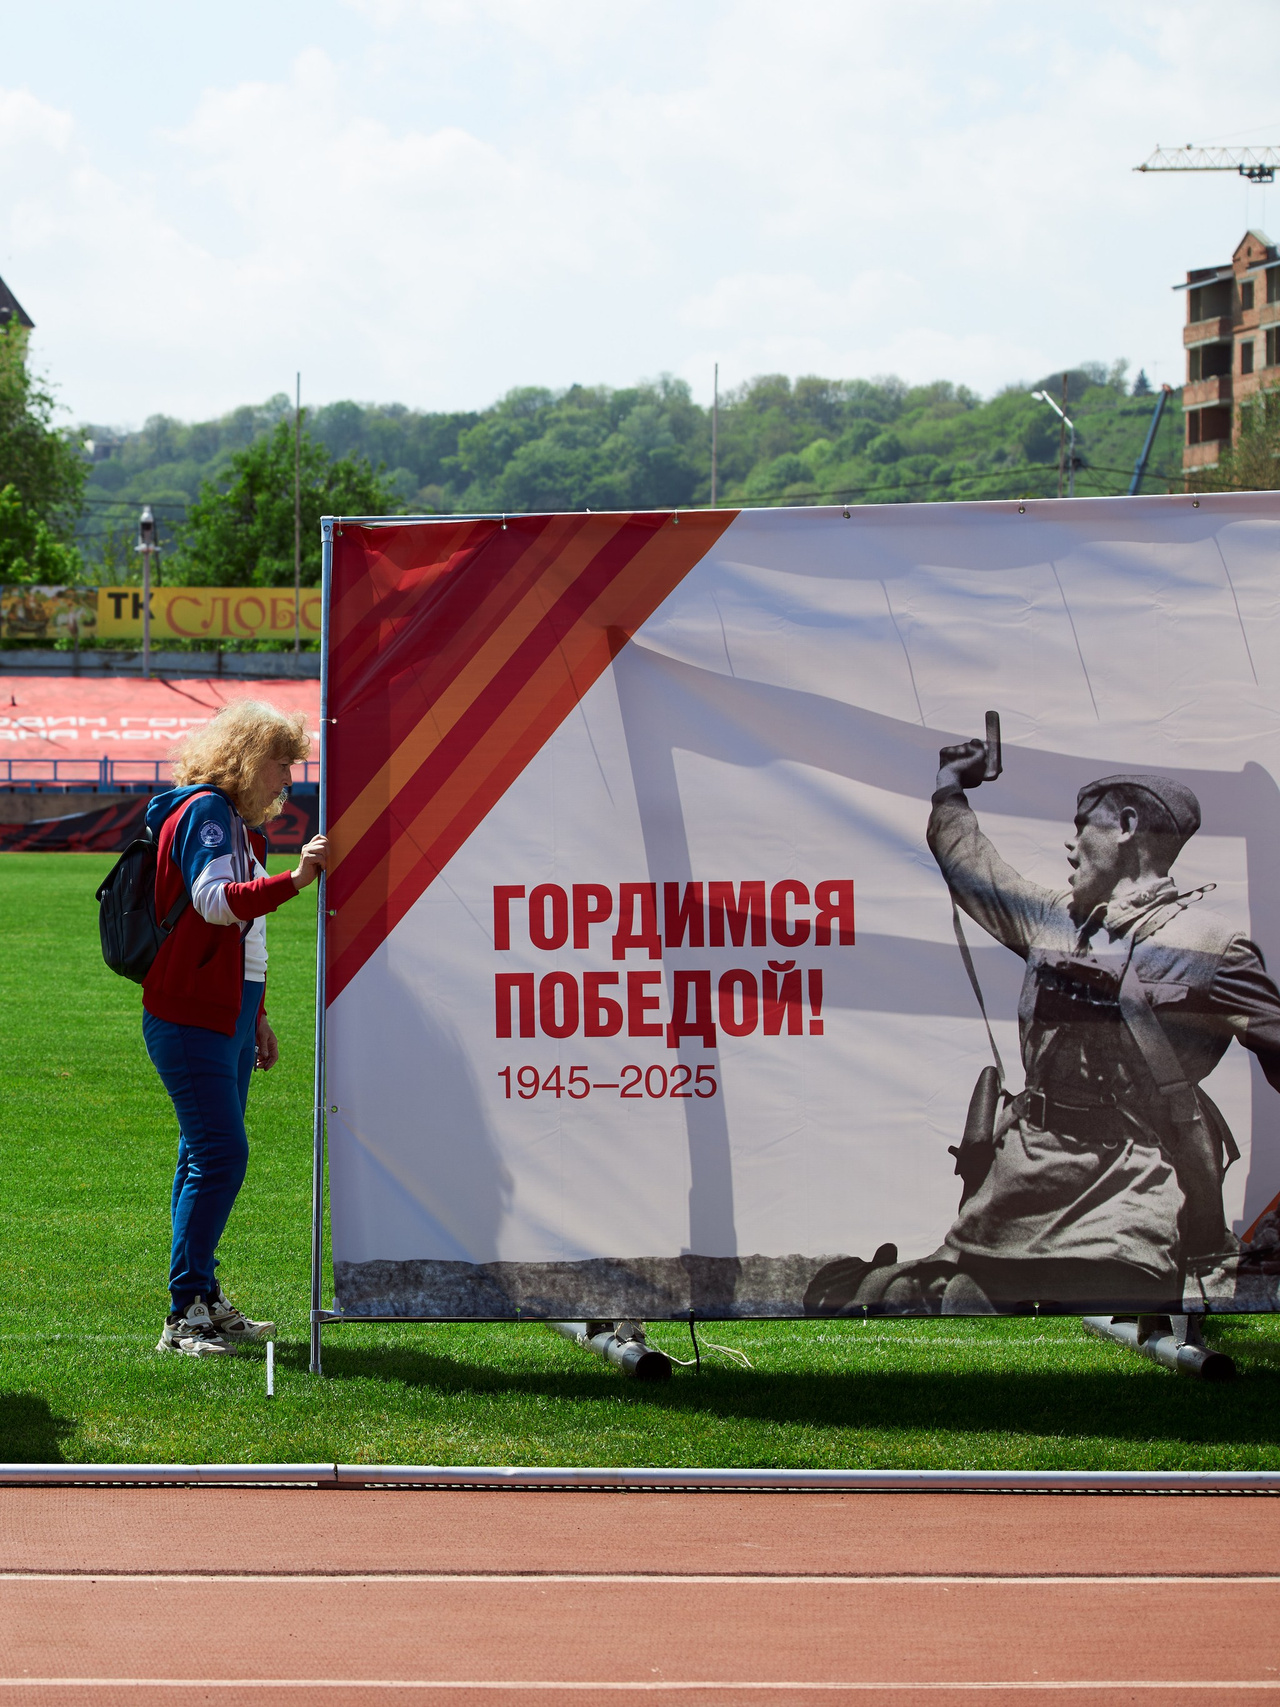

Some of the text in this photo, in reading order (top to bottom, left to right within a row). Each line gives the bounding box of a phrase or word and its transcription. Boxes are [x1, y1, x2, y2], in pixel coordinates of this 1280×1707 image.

[107, 592, 155, 620] ТК
[92, 729, 198, 740] КОМ
[120, 716, 210, 728] ГОР
[272, 814, 299, 836] 2
[493, 879, 856, 961] ГОРДИМСЯ
[495, 960, 825, 1049] ПОБЕДОЙ!
